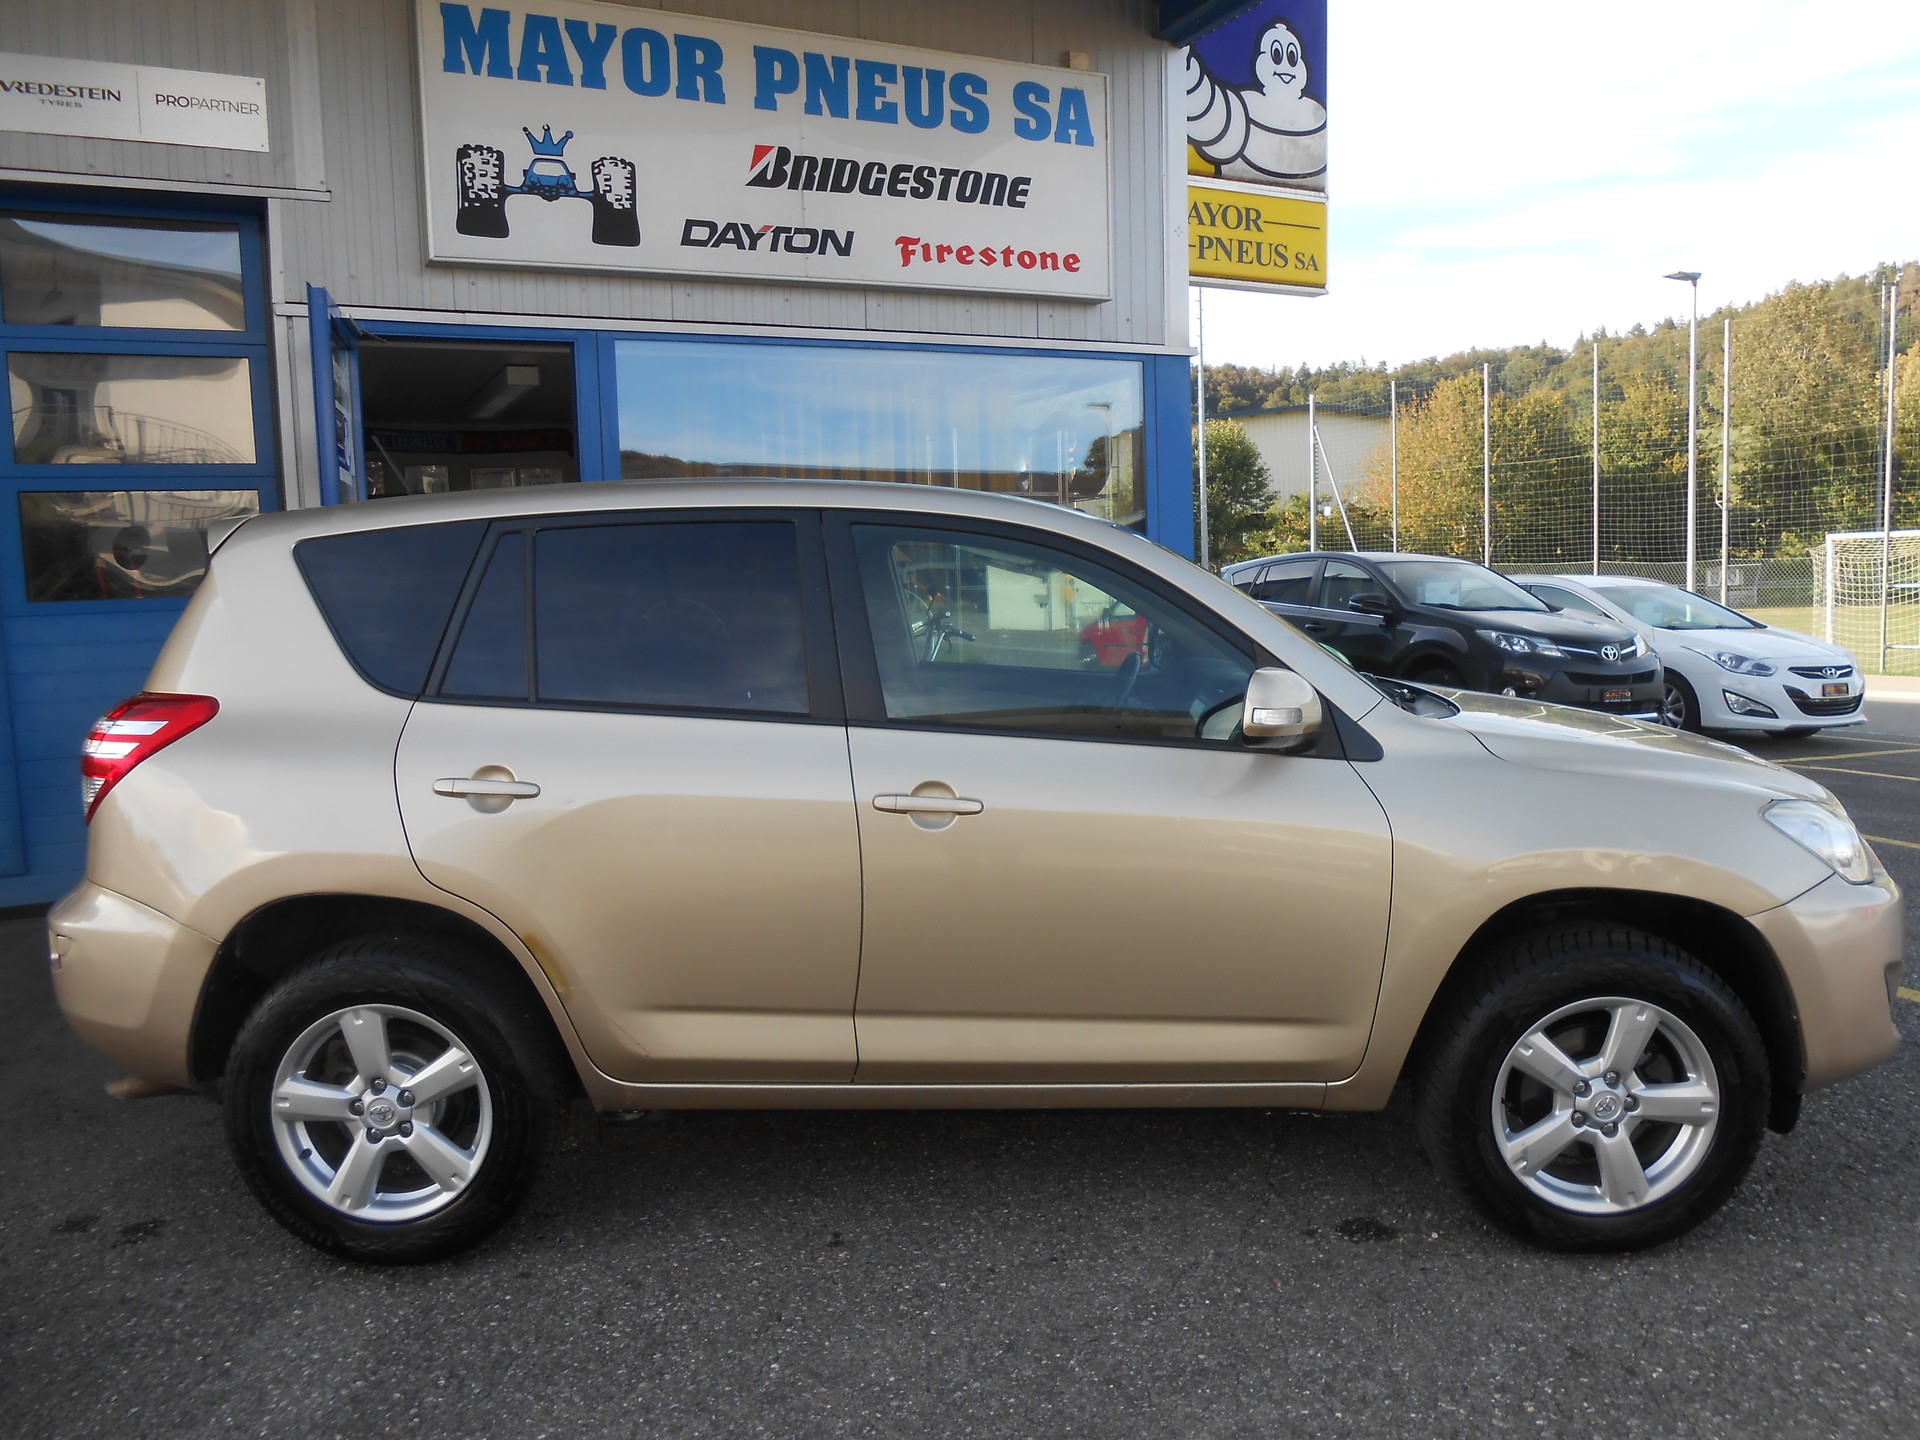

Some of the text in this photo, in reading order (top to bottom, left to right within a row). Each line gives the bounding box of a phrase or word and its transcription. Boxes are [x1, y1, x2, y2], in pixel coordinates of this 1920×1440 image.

[439, 2, 1095, 147] MAYOR PNEUS SA
[0, 80, 122, 102] VREDESTEIN
[39, 99, 82, 108] TYRES
[155, 93, 260, 115] PROPARTNER
[745, 144, 1032, 209] BRIDGESTONE
[1188, 201, 1264, 233] AYOR
[680, 218, 855, 257] DAYTON
[895, 235, 1081, 273] Firestone
[1295, 252, 1319, 272] SA
